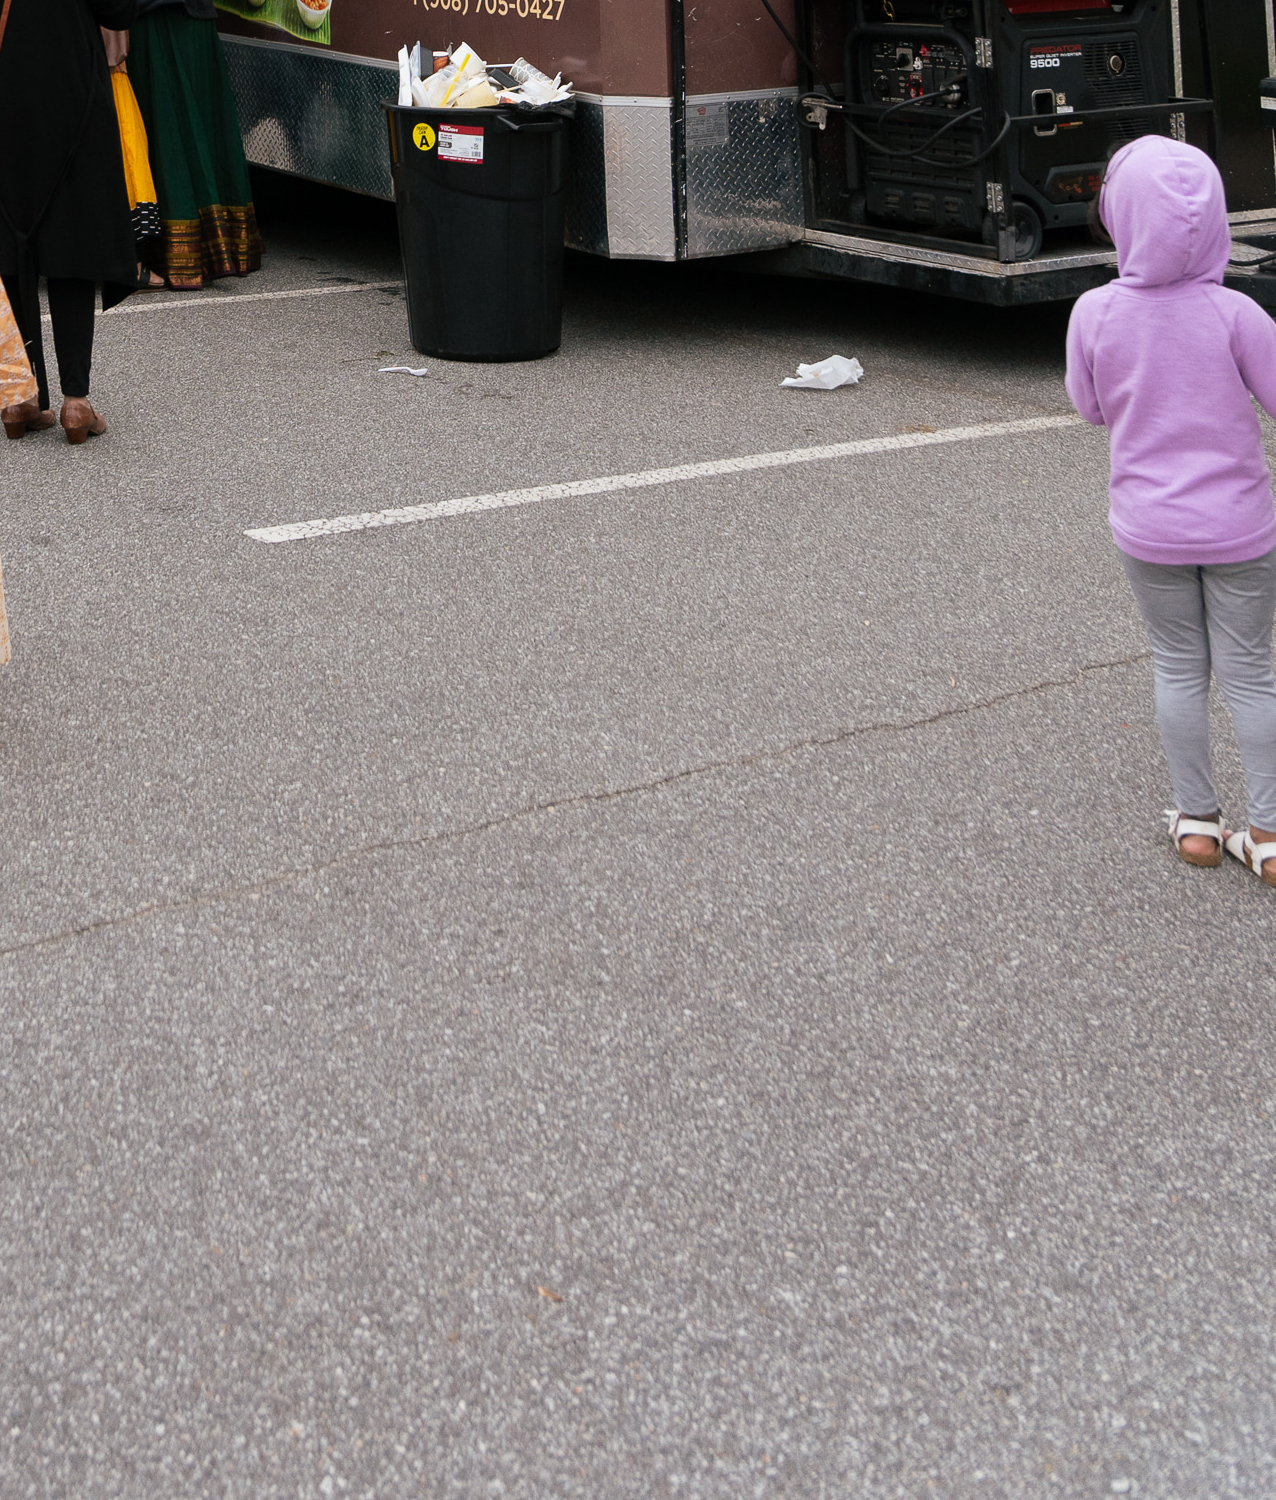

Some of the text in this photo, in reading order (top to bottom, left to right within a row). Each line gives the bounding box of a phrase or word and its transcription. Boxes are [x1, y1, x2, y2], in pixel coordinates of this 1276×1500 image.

[1030, 44, 1082, 54] PREDATOR
[1030, 58, 1060, 68] 9500
[420, 135, 430, 147] A
